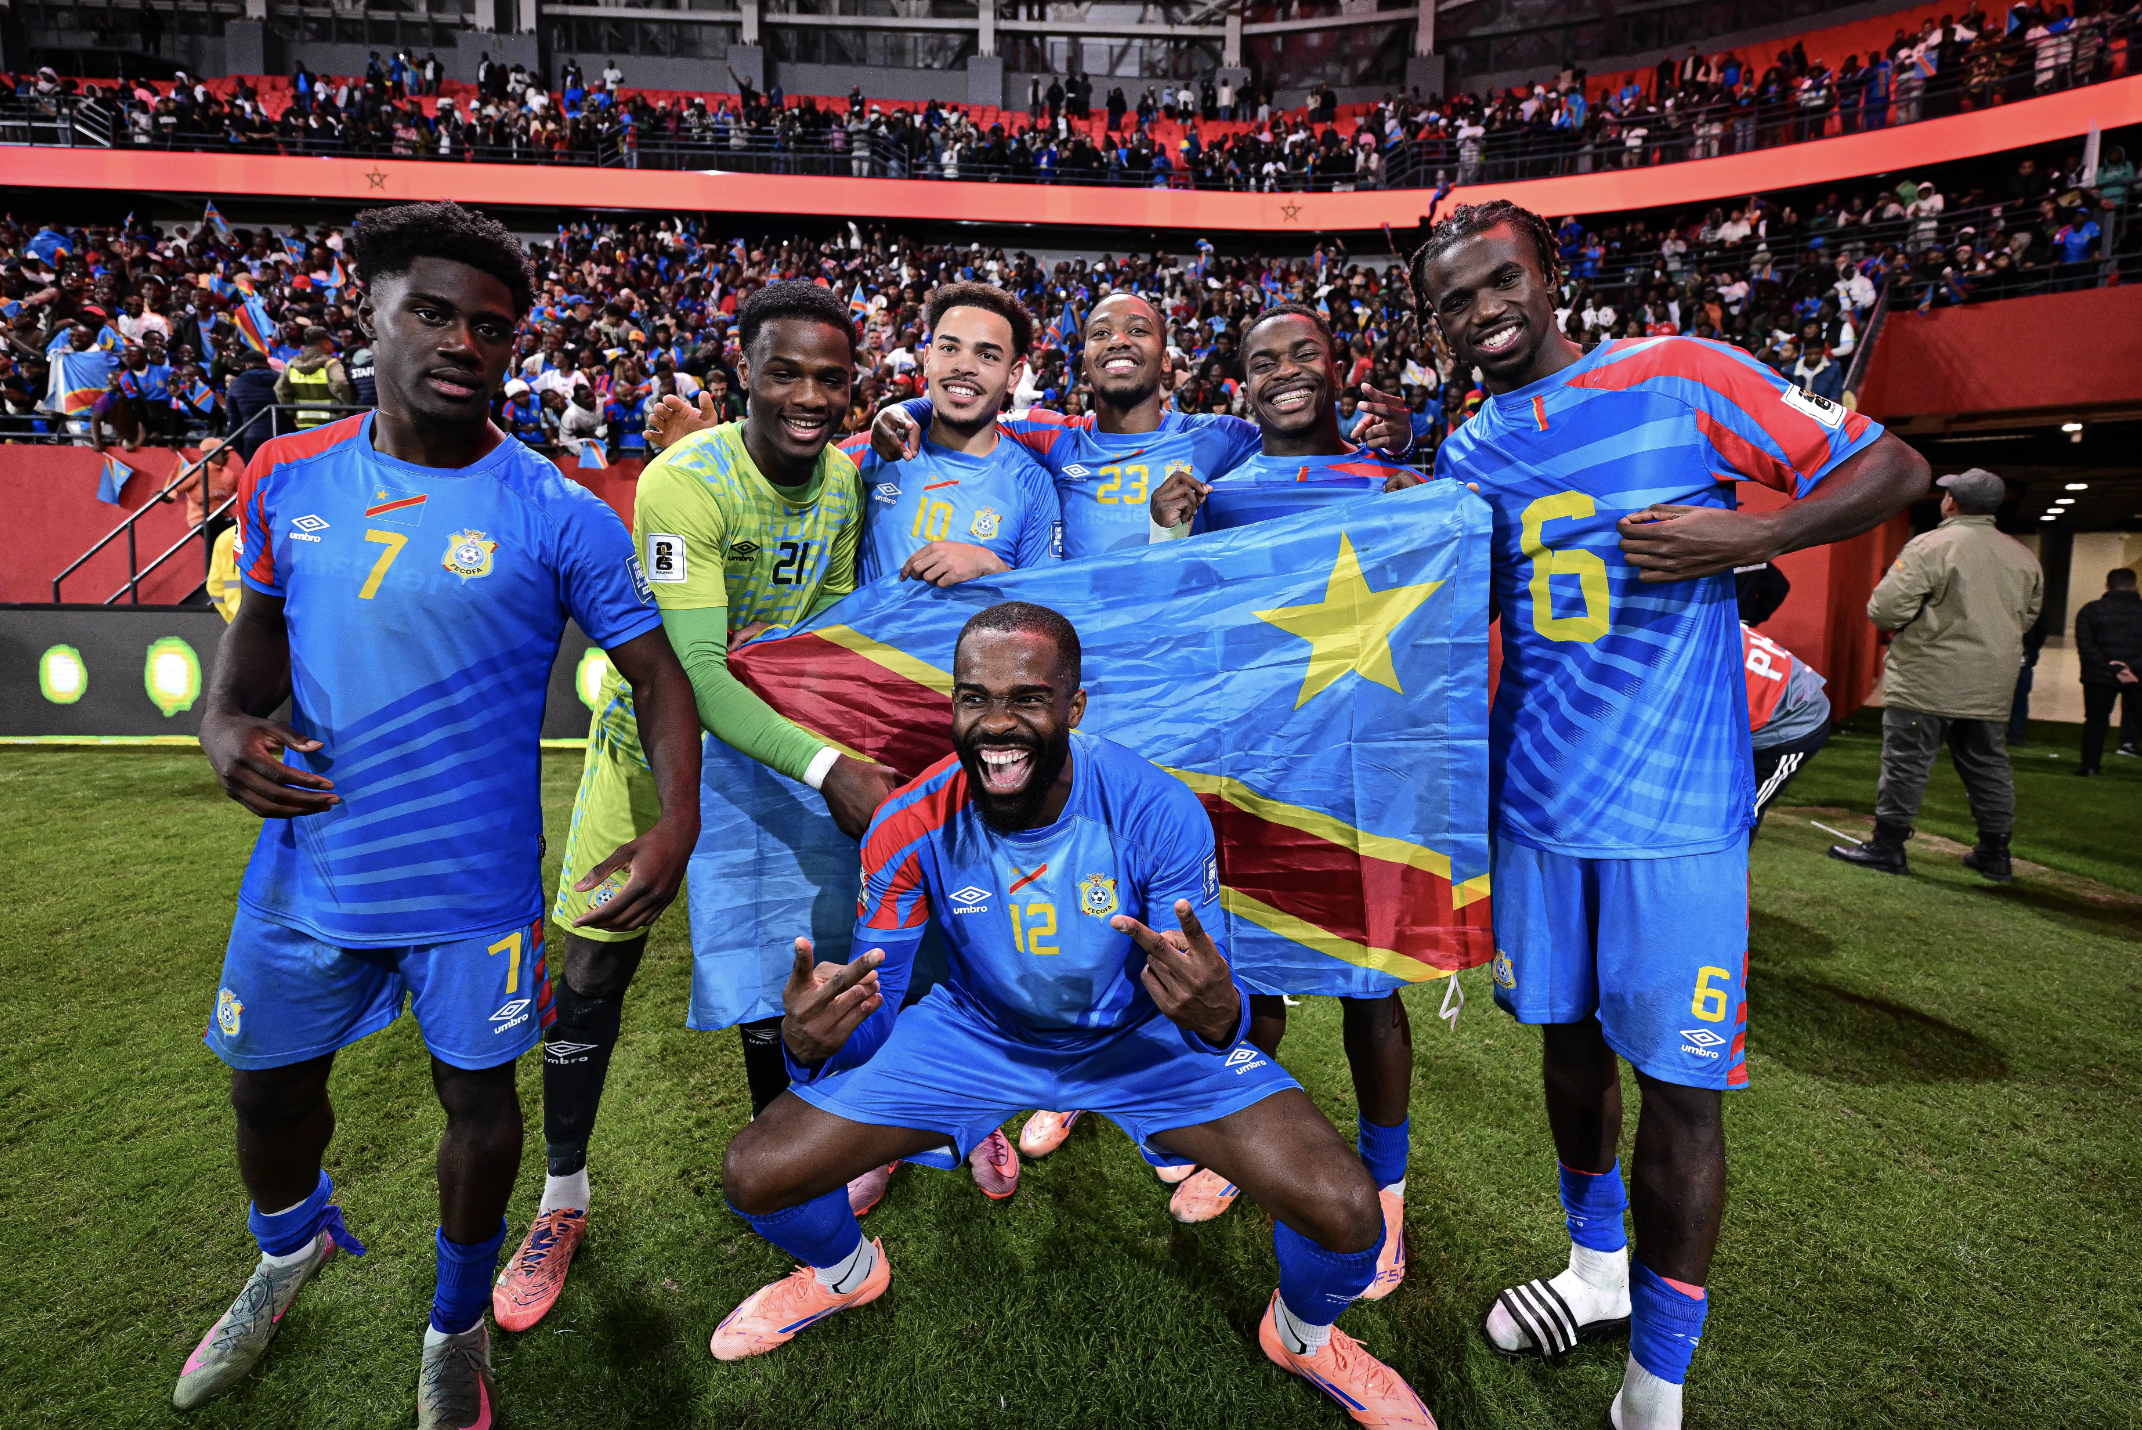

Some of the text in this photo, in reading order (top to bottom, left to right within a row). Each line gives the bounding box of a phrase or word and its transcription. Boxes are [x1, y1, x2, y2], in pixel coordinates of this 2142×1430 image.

[875, 494, 897, 505] umbro
[1097, 465, 1149, 504] 23
[289, 532, 322, 543] umbro
[911, 496, 953, 542] 10
[358, 529, 409, 600] 7
[450, 563, 483, 575] FECOFA
[772, 542, 810, 585] 21
[1520, 489, 1610, 643] 6
[953, 905, 988, 915] umbro
[1009, 903, 1060, 955] 12
[487, 931, 522, 994] 7
[1691, 965, 1730, 1022] 6
[494, 1013, 529, 1035] umbro
[1235, 1059, 1267, 1075] umbro
[1681, 1043, 1719, 1059] umbro
